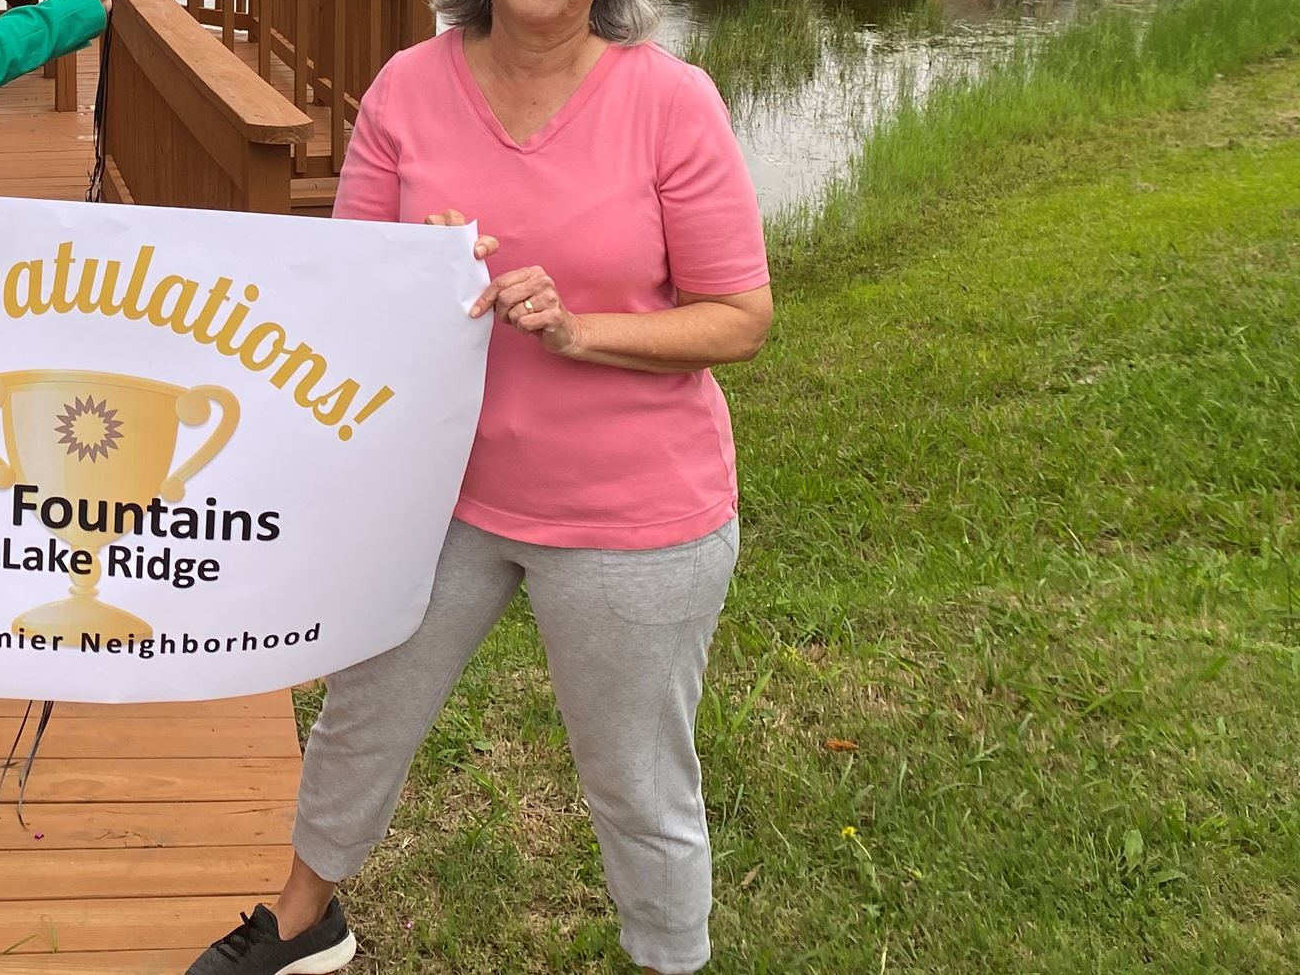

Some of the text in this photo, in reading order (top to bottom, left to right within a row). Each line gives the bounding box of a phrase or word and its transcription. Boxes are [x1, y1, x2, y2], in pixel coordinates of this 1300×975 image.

[12, 484, 280, 542] Fountains
[2, 537, 93, 575] Lake
[108, 545, 220, 589] Ridge
[81, 622, 321, 659] Neighborhood
